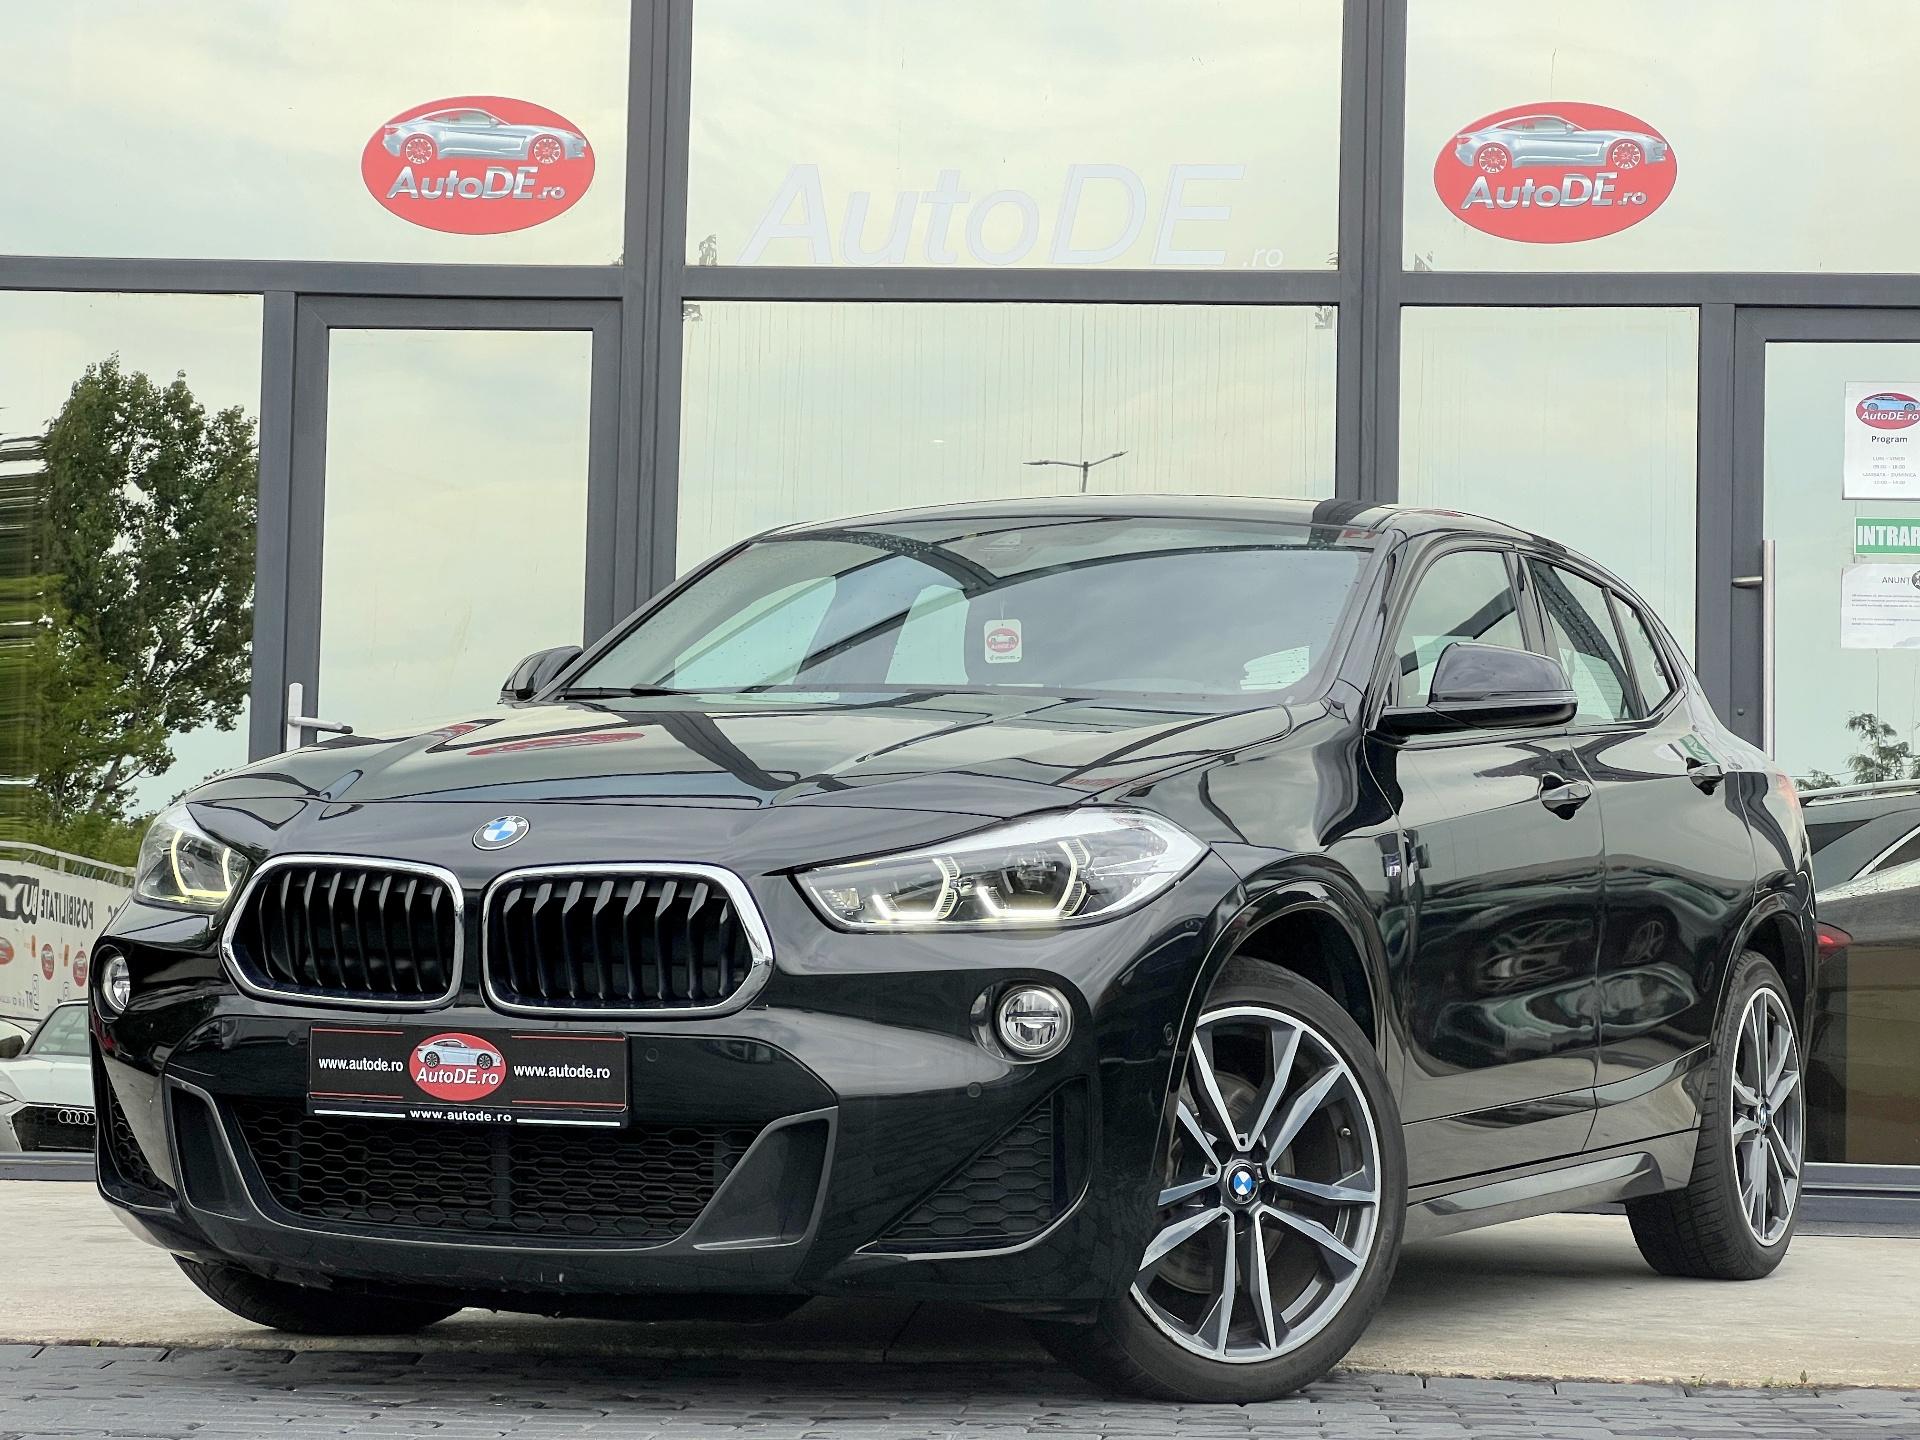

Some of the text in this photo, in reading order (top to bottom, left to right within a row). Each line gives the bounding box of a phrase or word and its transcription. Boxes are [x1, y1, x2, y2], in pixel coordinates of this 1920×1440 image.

[1860, 411, 1919, 421] AutoDE.ro
[1871, 435, 1908, 444] Program
[318, 1057, 404, 1072] www.autode.ro
[513, 1063, 611, 1079] www.autode.ro
[416, 1067, 499, 1086] AutoDE.ro
[410, 1108, 512, 1123] www.autode.ro
